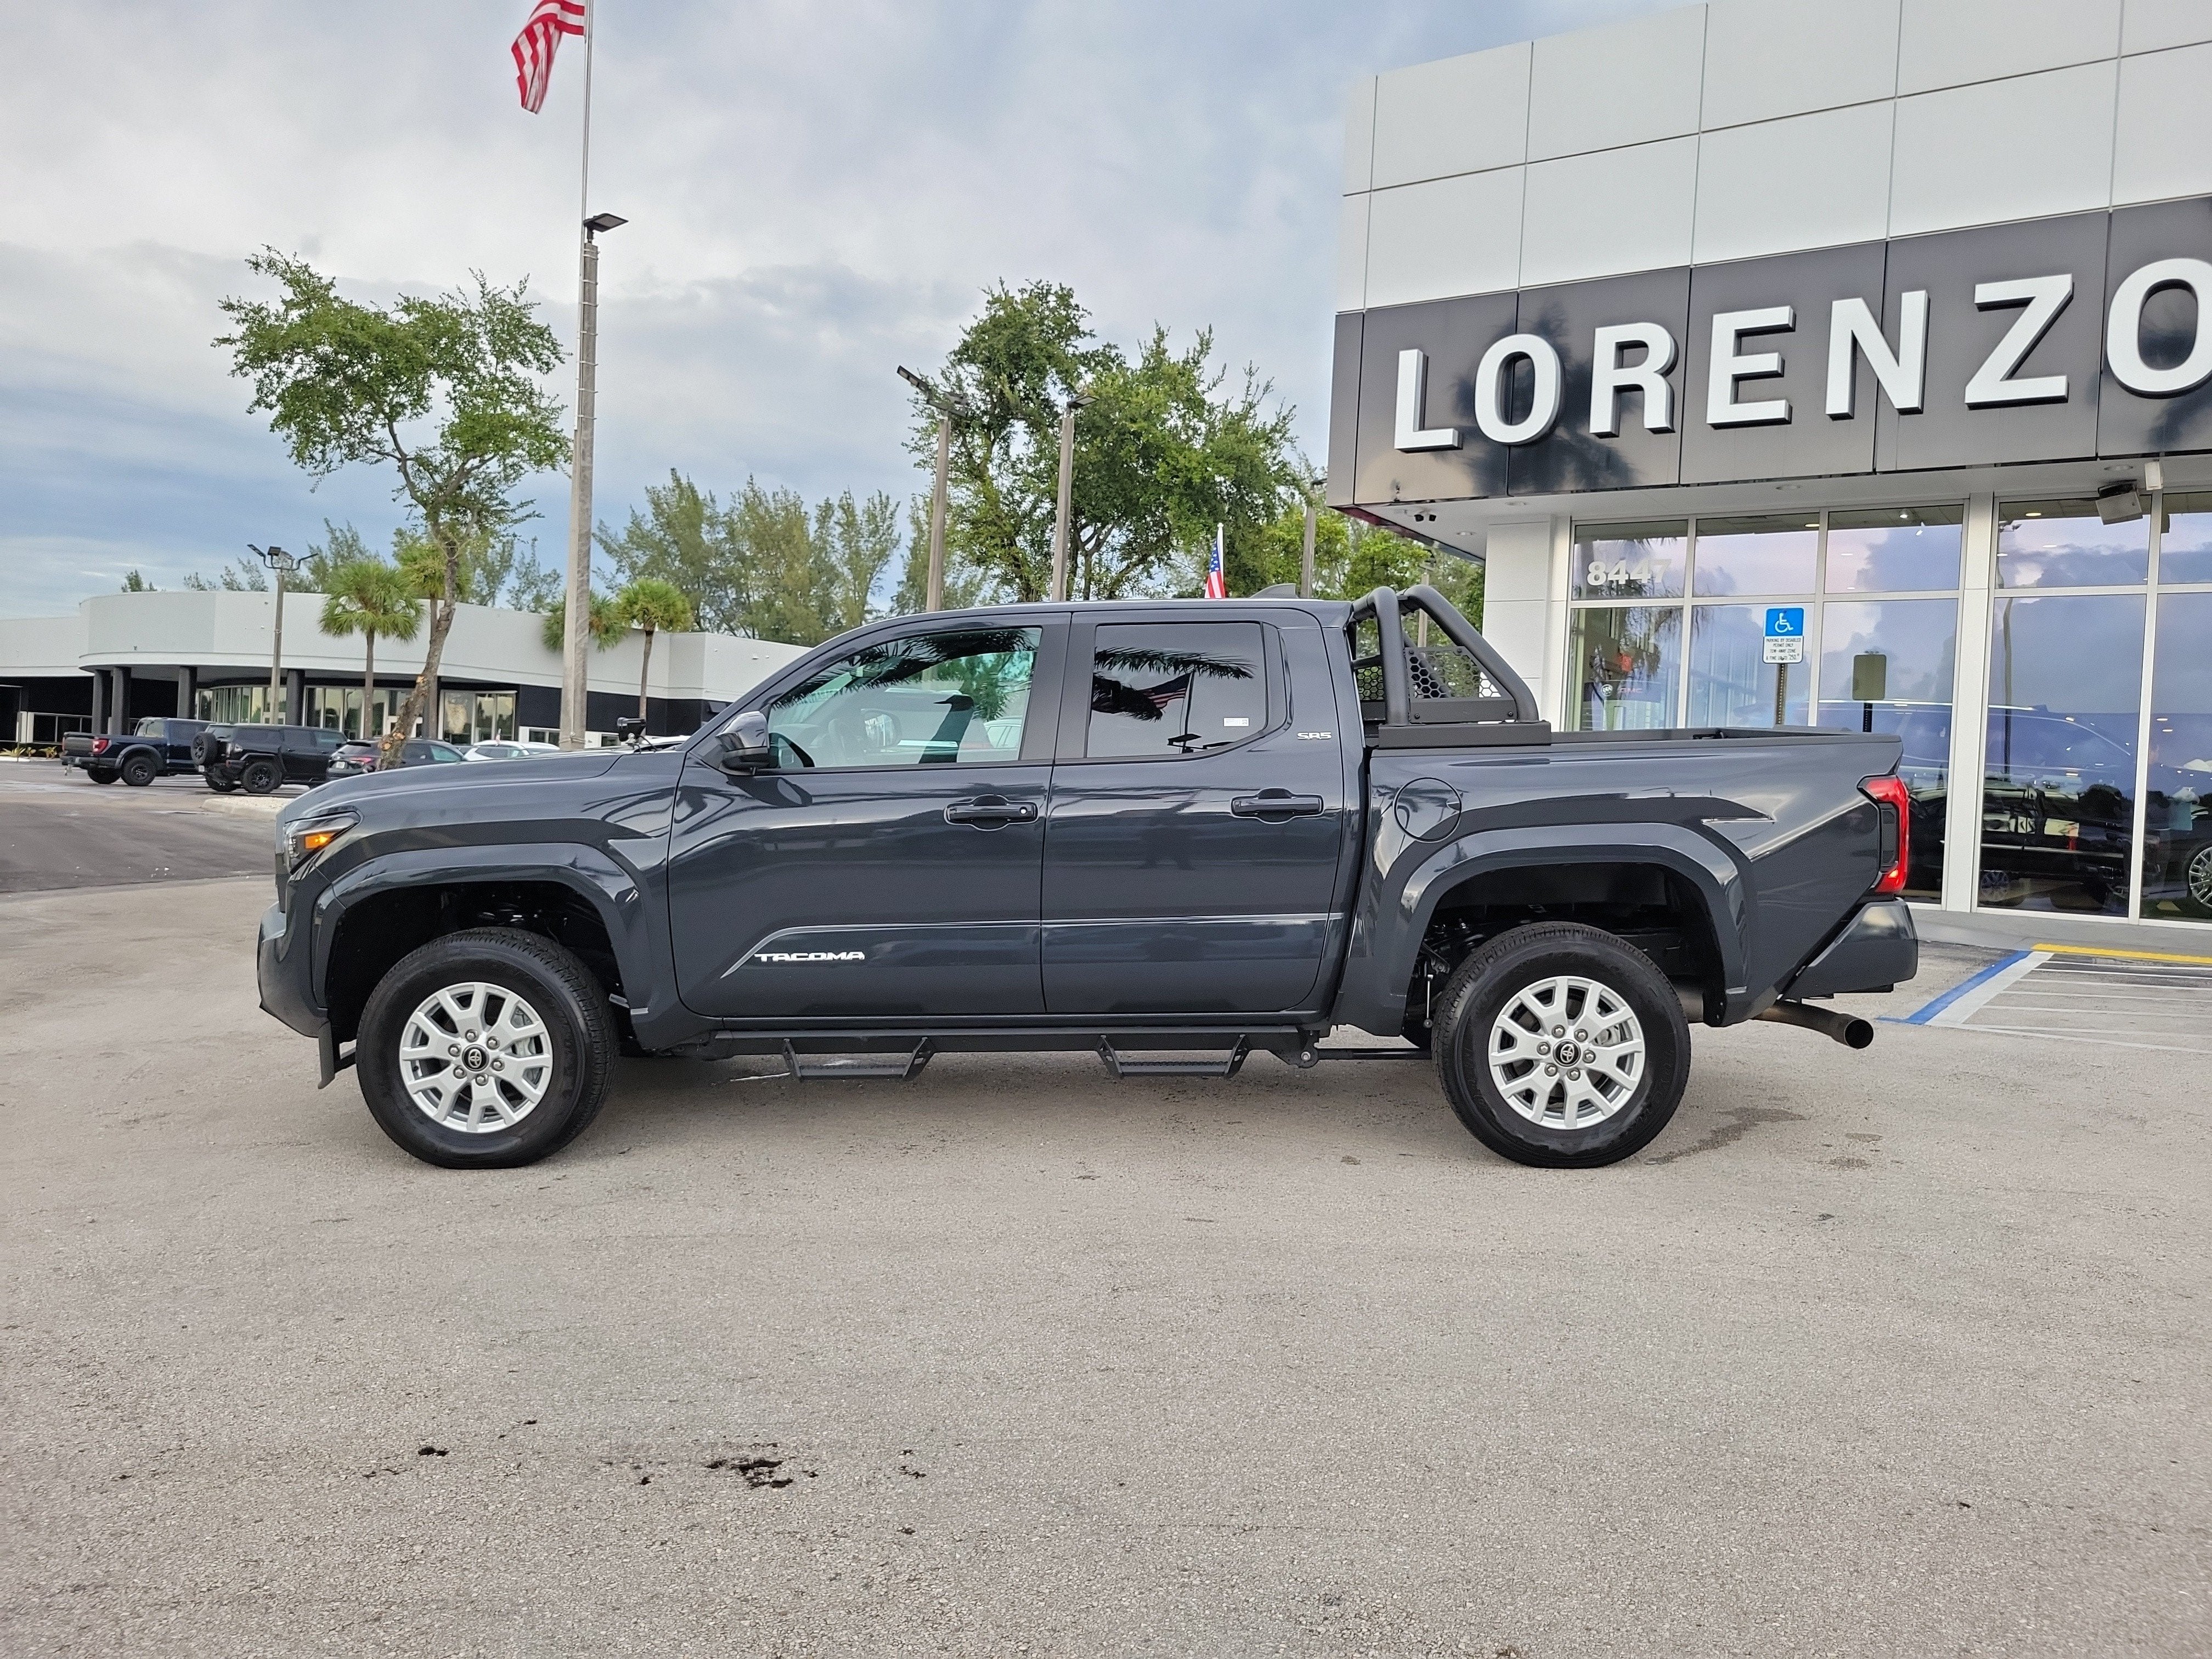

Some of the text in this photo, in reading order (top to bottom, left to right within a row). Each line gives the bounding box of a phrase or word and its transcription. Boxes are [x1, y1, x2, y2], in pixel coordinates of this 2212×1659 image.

[1394, 258, 2212, 452] LORENZO
[1587, 558, 1672, 586] 8447
[1297, 732, 1332, 740] SR5
[754, 951, 865, 962] TACOMA
